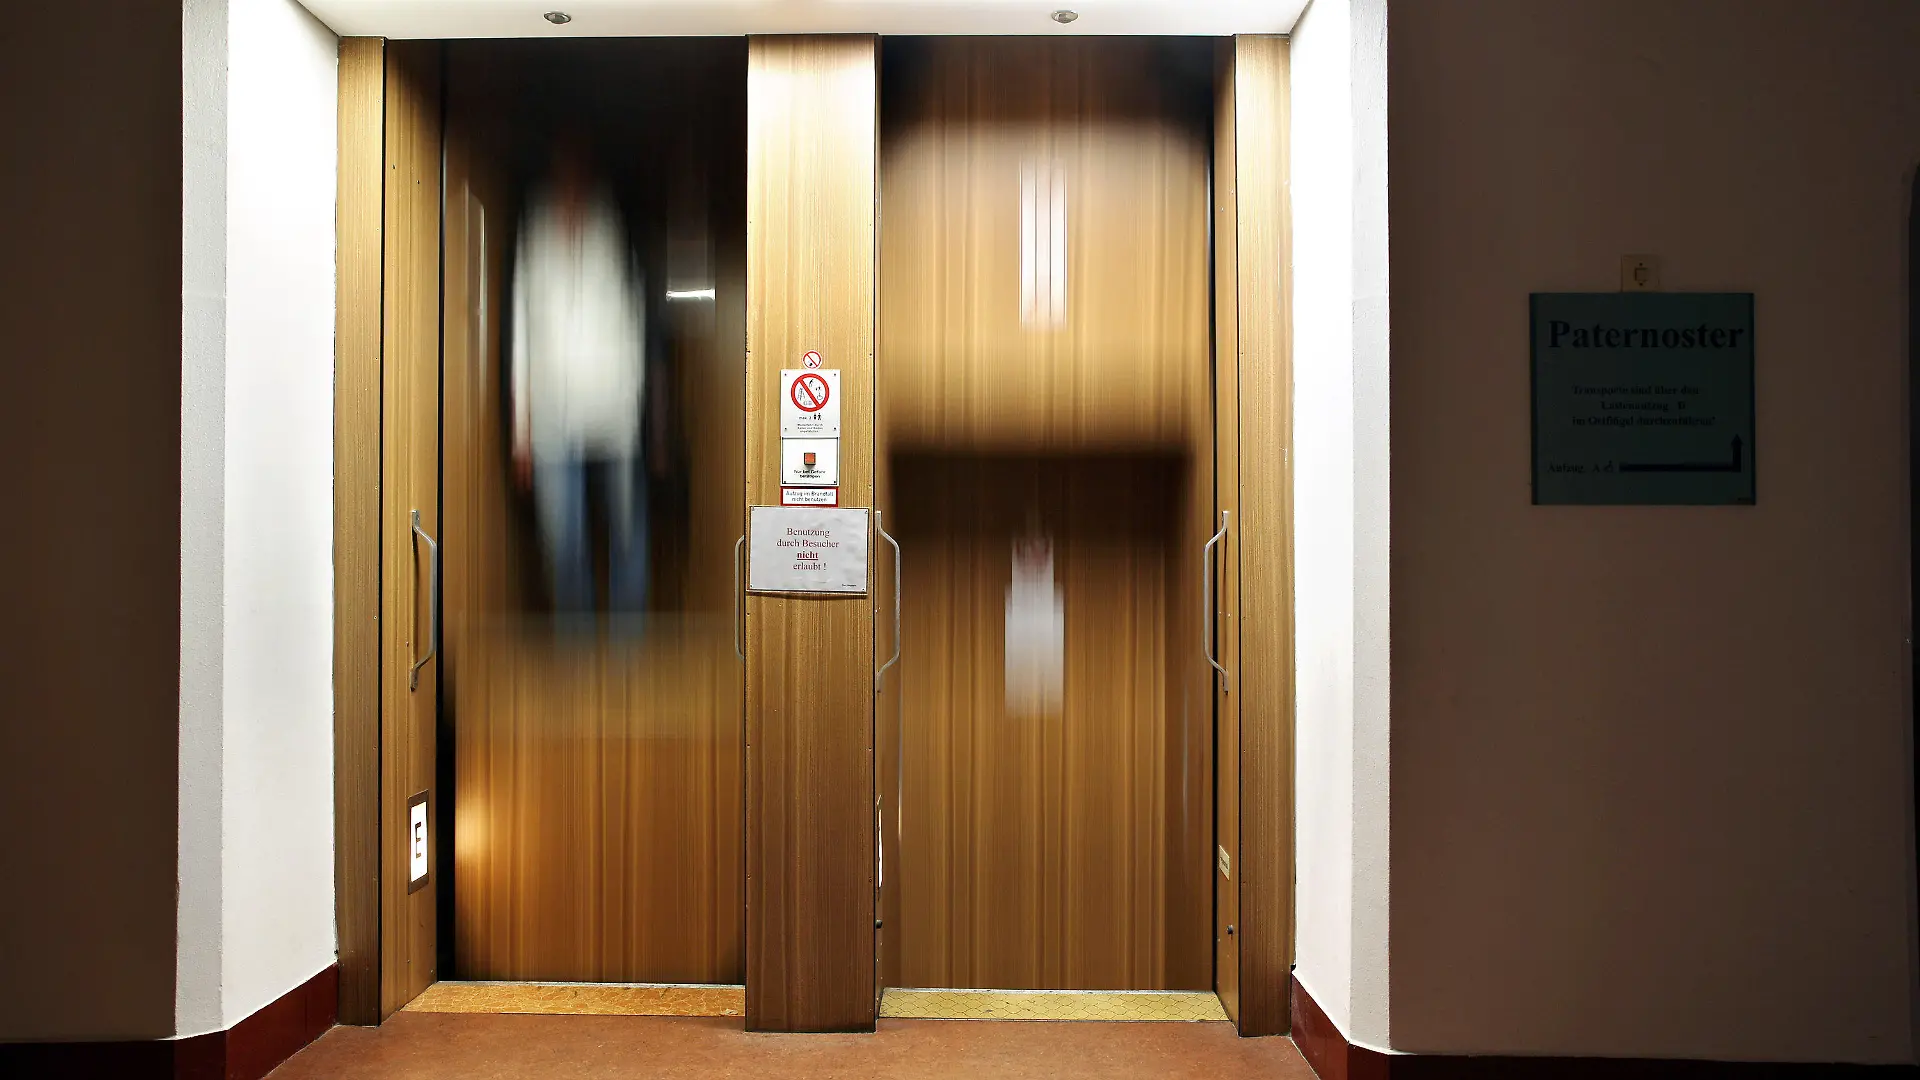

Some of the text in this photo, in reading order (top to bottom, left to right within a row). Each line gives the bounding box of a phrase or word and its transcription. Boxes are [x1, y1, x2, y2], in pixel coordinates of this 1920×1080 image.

[1548, 320, 1744, 348] Paternoster
[1630, 384, 1651, 395] sind
[1654, 384, 1677, 395] über
[1680, 384, 1699, 395] den
[1572, 416, 1586, 426] im
[786, 527, 830, 538] Benutzung
[776, 539, 839, 548] durch Besucher
[796, 550, 819, 560] nicht
[414, 821, 422, 859] E
